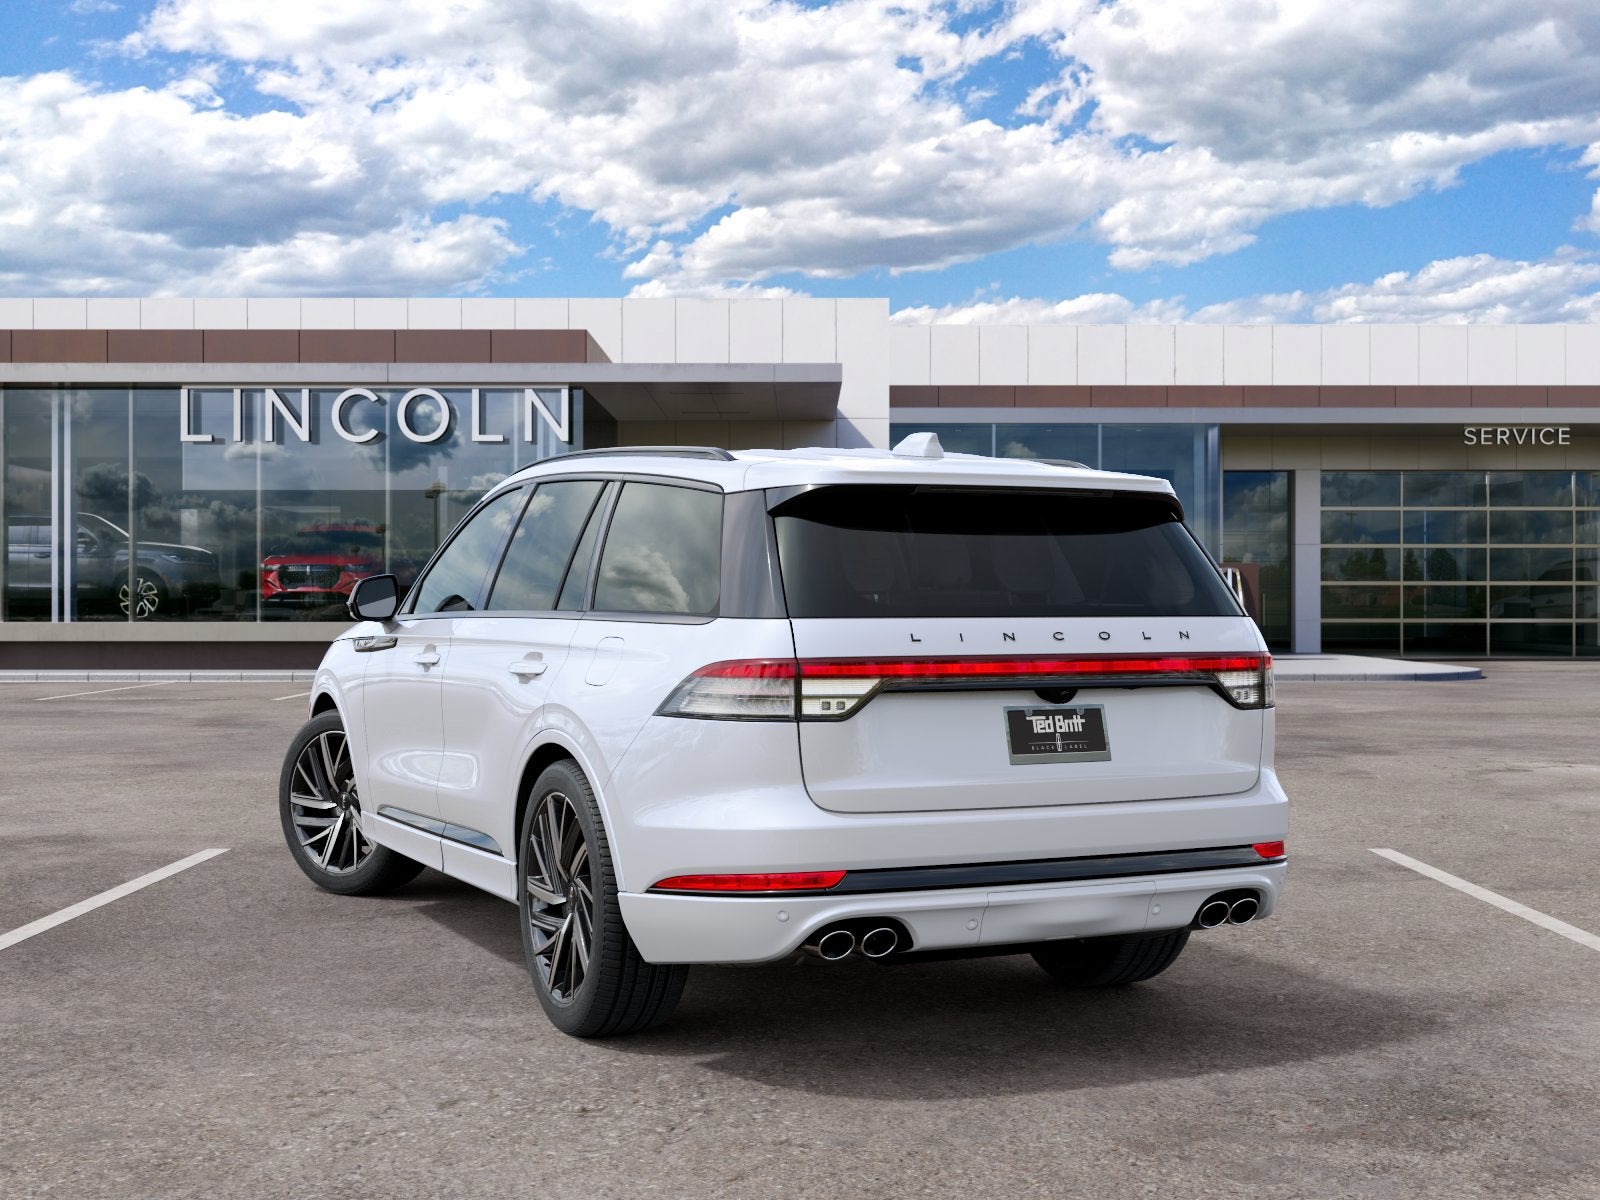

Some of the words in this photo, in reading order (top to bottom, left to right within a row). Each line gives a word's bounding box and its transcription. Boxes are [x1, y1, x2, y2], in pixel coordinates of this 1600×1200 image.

[179, 388, 569, 443] LINCOLN
[1464, 427, 1570, 445] SERVICE
[910, 630, 1190, 643] LINCOLN
[1026, 715, 1054, 733] Ted
[1054, 714, 1086, 733] Britt
